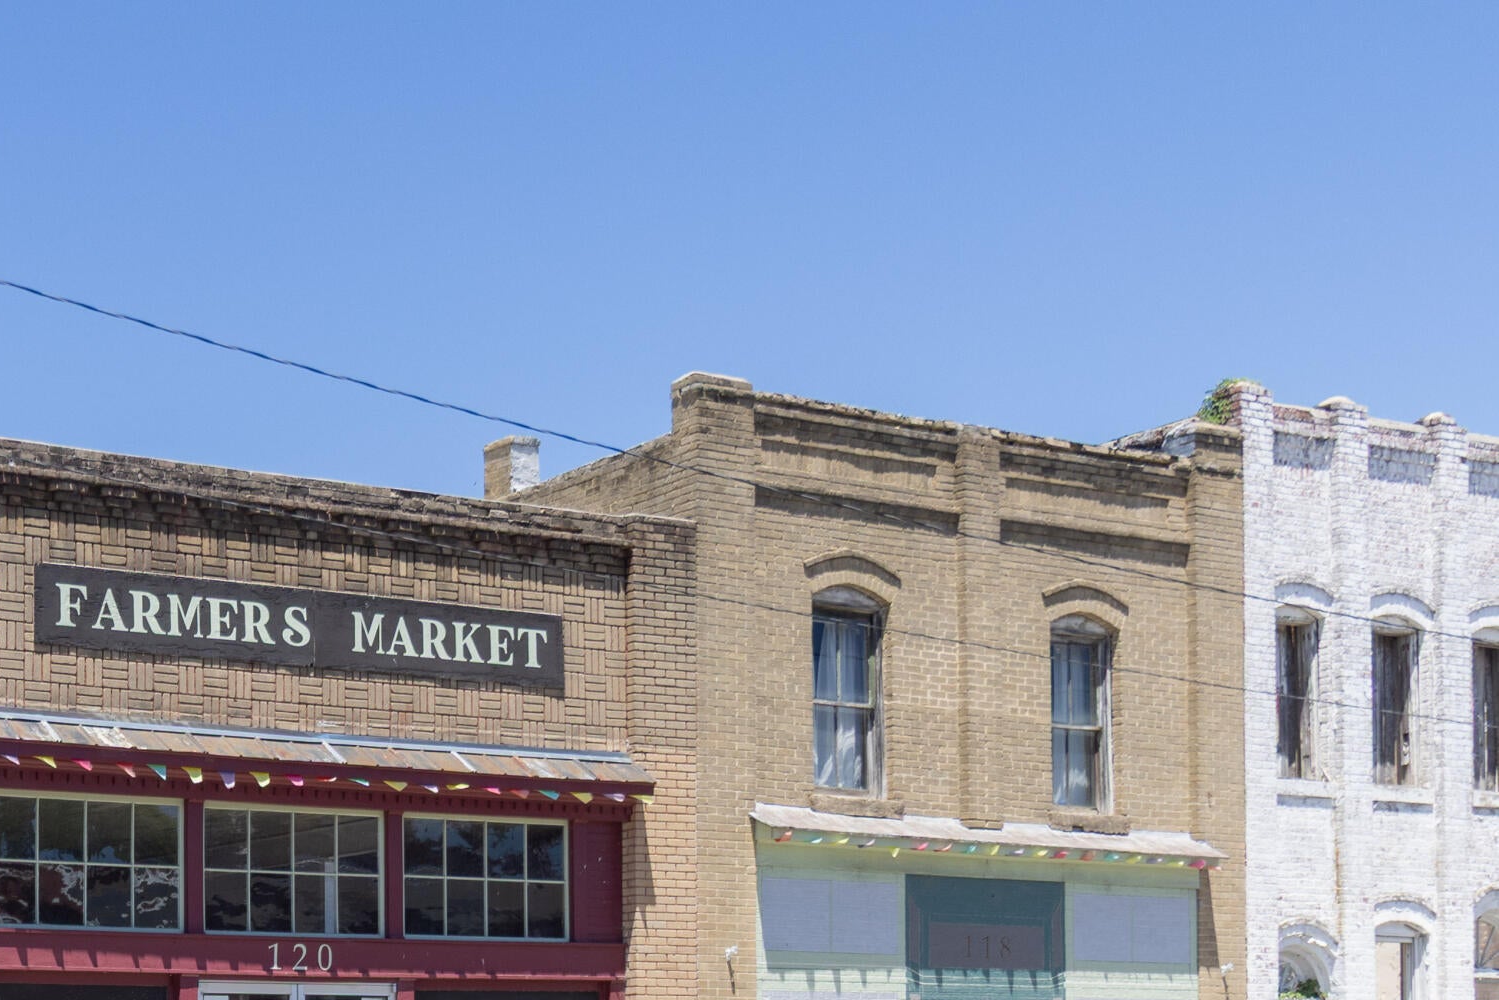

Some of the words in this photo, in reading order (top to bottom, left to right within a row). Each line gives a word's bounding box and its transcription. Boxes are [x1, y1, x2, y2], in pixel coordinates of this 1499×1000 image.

[54, 582, 312, 648] FARMERS
[351, 611, 548, 669] MARKET
[268, 942, 333, 971] 120
[963, 934, 1012, 960] 118
